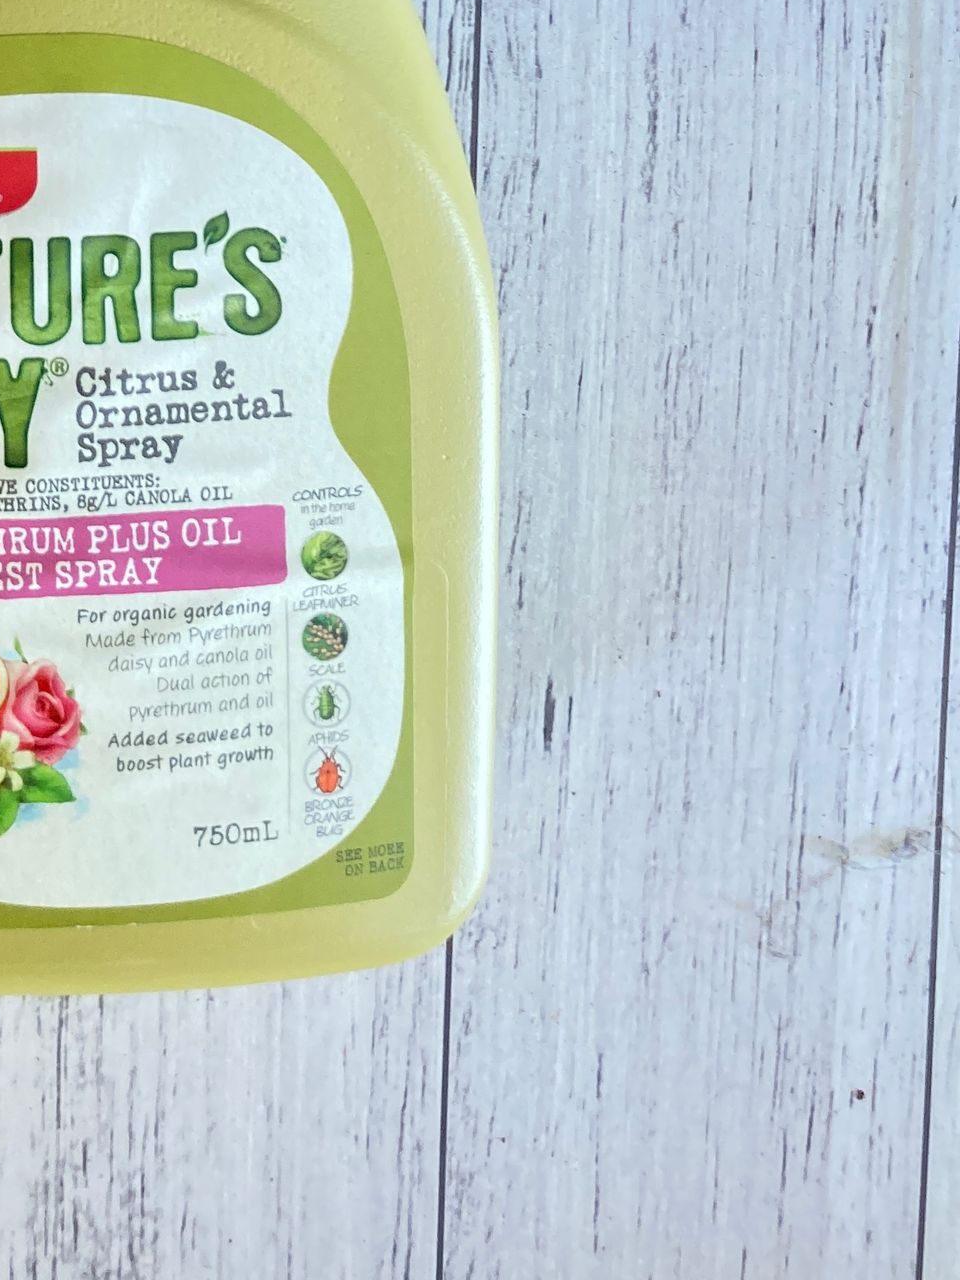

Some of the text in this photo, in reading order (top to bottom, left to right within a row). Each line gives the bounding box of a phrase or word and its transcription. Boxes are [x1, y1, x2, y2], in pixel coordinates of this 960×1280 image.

[75, 361, 236, 397] Citrus &
[76, 390, 292, 429] Ornamental
[77, 432, 183, 467] Spray
[25, 473, 161, 493] CONSTITUENTS:
[292, 485, 364, 502] CONTROLS
[77, 492, 117, 511] 8g/L
[124, 489, 192, 507] CANOLA
[200, 486, 233, 502] OIL
[301, 501, 356, 514] in the home
[87, 522, 170, 554] PLUS
[181, 517, 242, 547] OIL
[56, 557, 163, 589] SPRAY
[292, 594, 360, 612] LEAFMINER
[302, 583, 348, 598] CITRUS
[77, 599, 271, 626] For organic gardening
[85, 623, 272, 649] Made from Pyrethrum
[108, 644, 272, 674] daisy and canola oil
[308, 662, 346, 677] SCALE
[157, 667, 273, 693] Dual action of
[129, 692, 273, 722] pyrethrum and oil
[107, 722, 273, 748] Added seaweed to
[308, 729, 350, 746] APHIDS
[116, 746, 274, 772] boost plant growth
[304, 796, 354, 813] BRONZE
[303, 809, 355, 826] ORANGE
[193, 820, 279, 848] 750mL
[316, 824, 344, 838] BUG
[336, 842, 405, 863] SEE MORE
[345, 857, 404, 876] ON BACK
